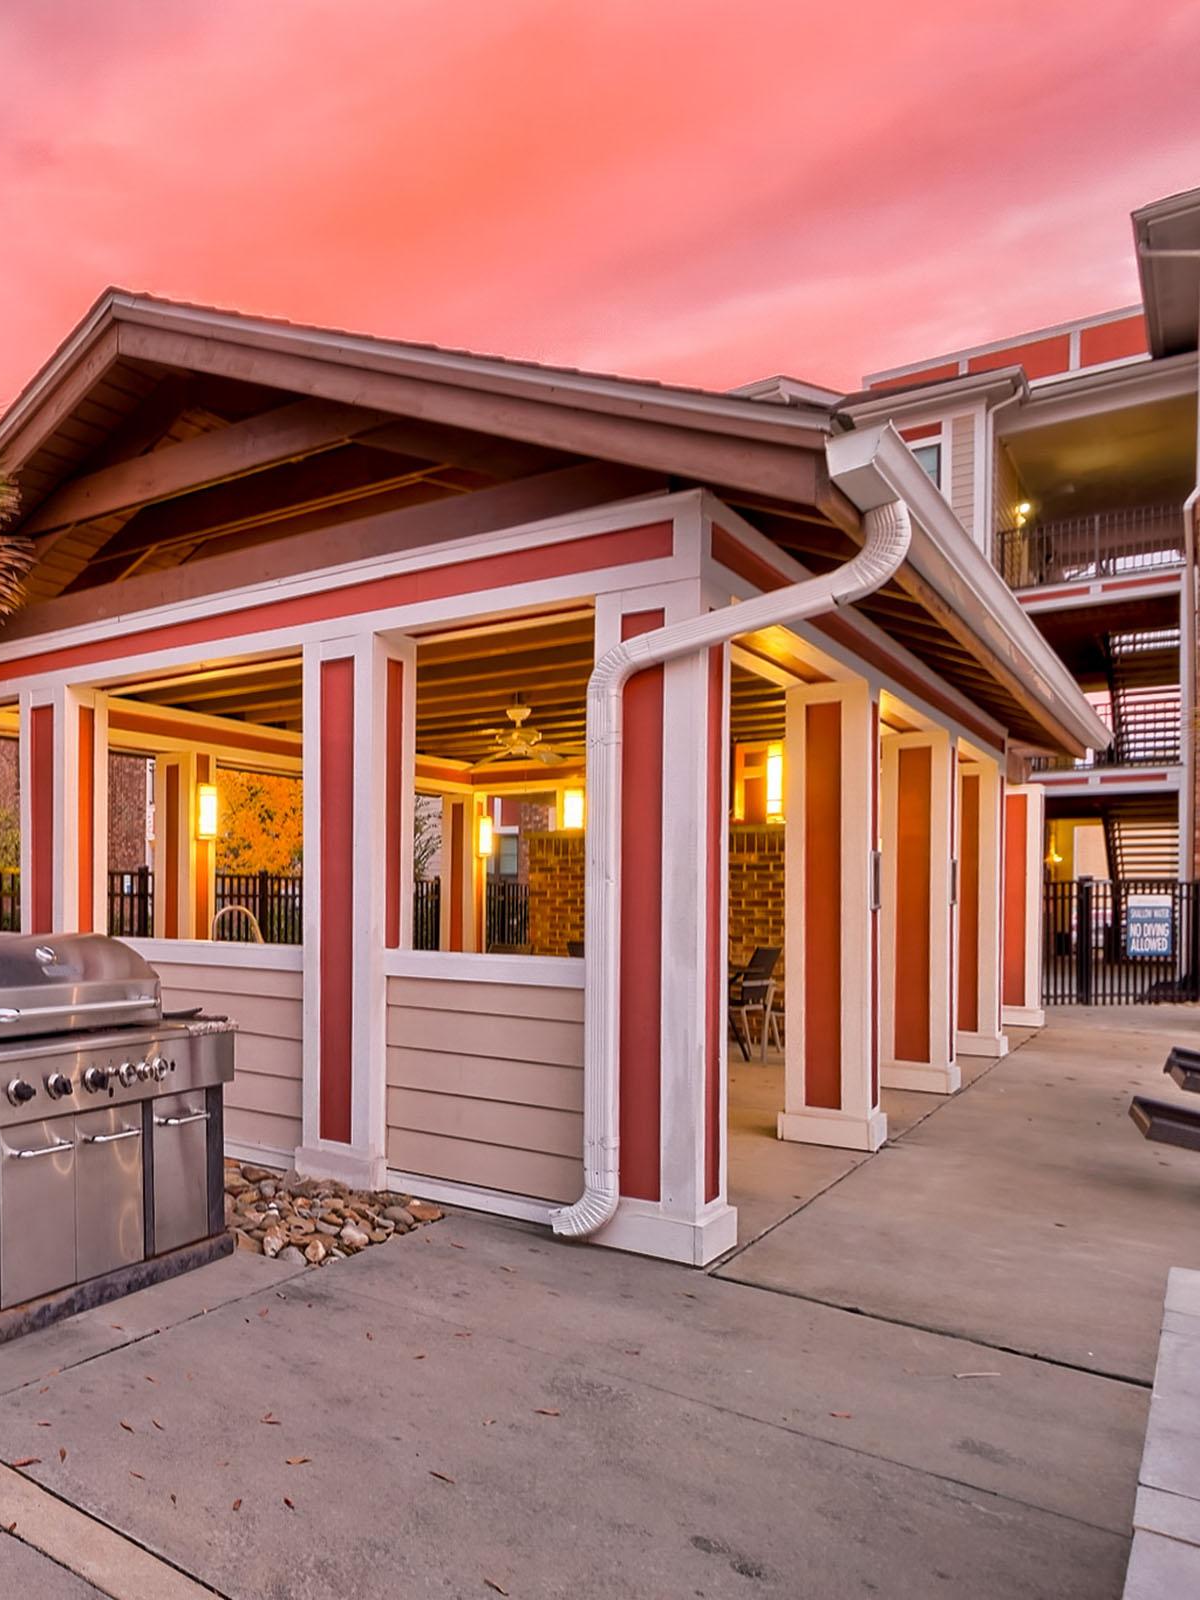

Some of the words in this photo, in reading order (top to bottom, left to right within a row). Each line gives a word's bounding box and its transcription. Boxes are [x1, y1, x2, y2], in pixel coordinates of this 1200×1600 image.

[1153, 908, 1169, 918] WATER
[1130, 922, 1142, 937] NO
[1143, 922, 1169, 937] DIVING
[1130, 937, 1168, 952] ALLOWED
